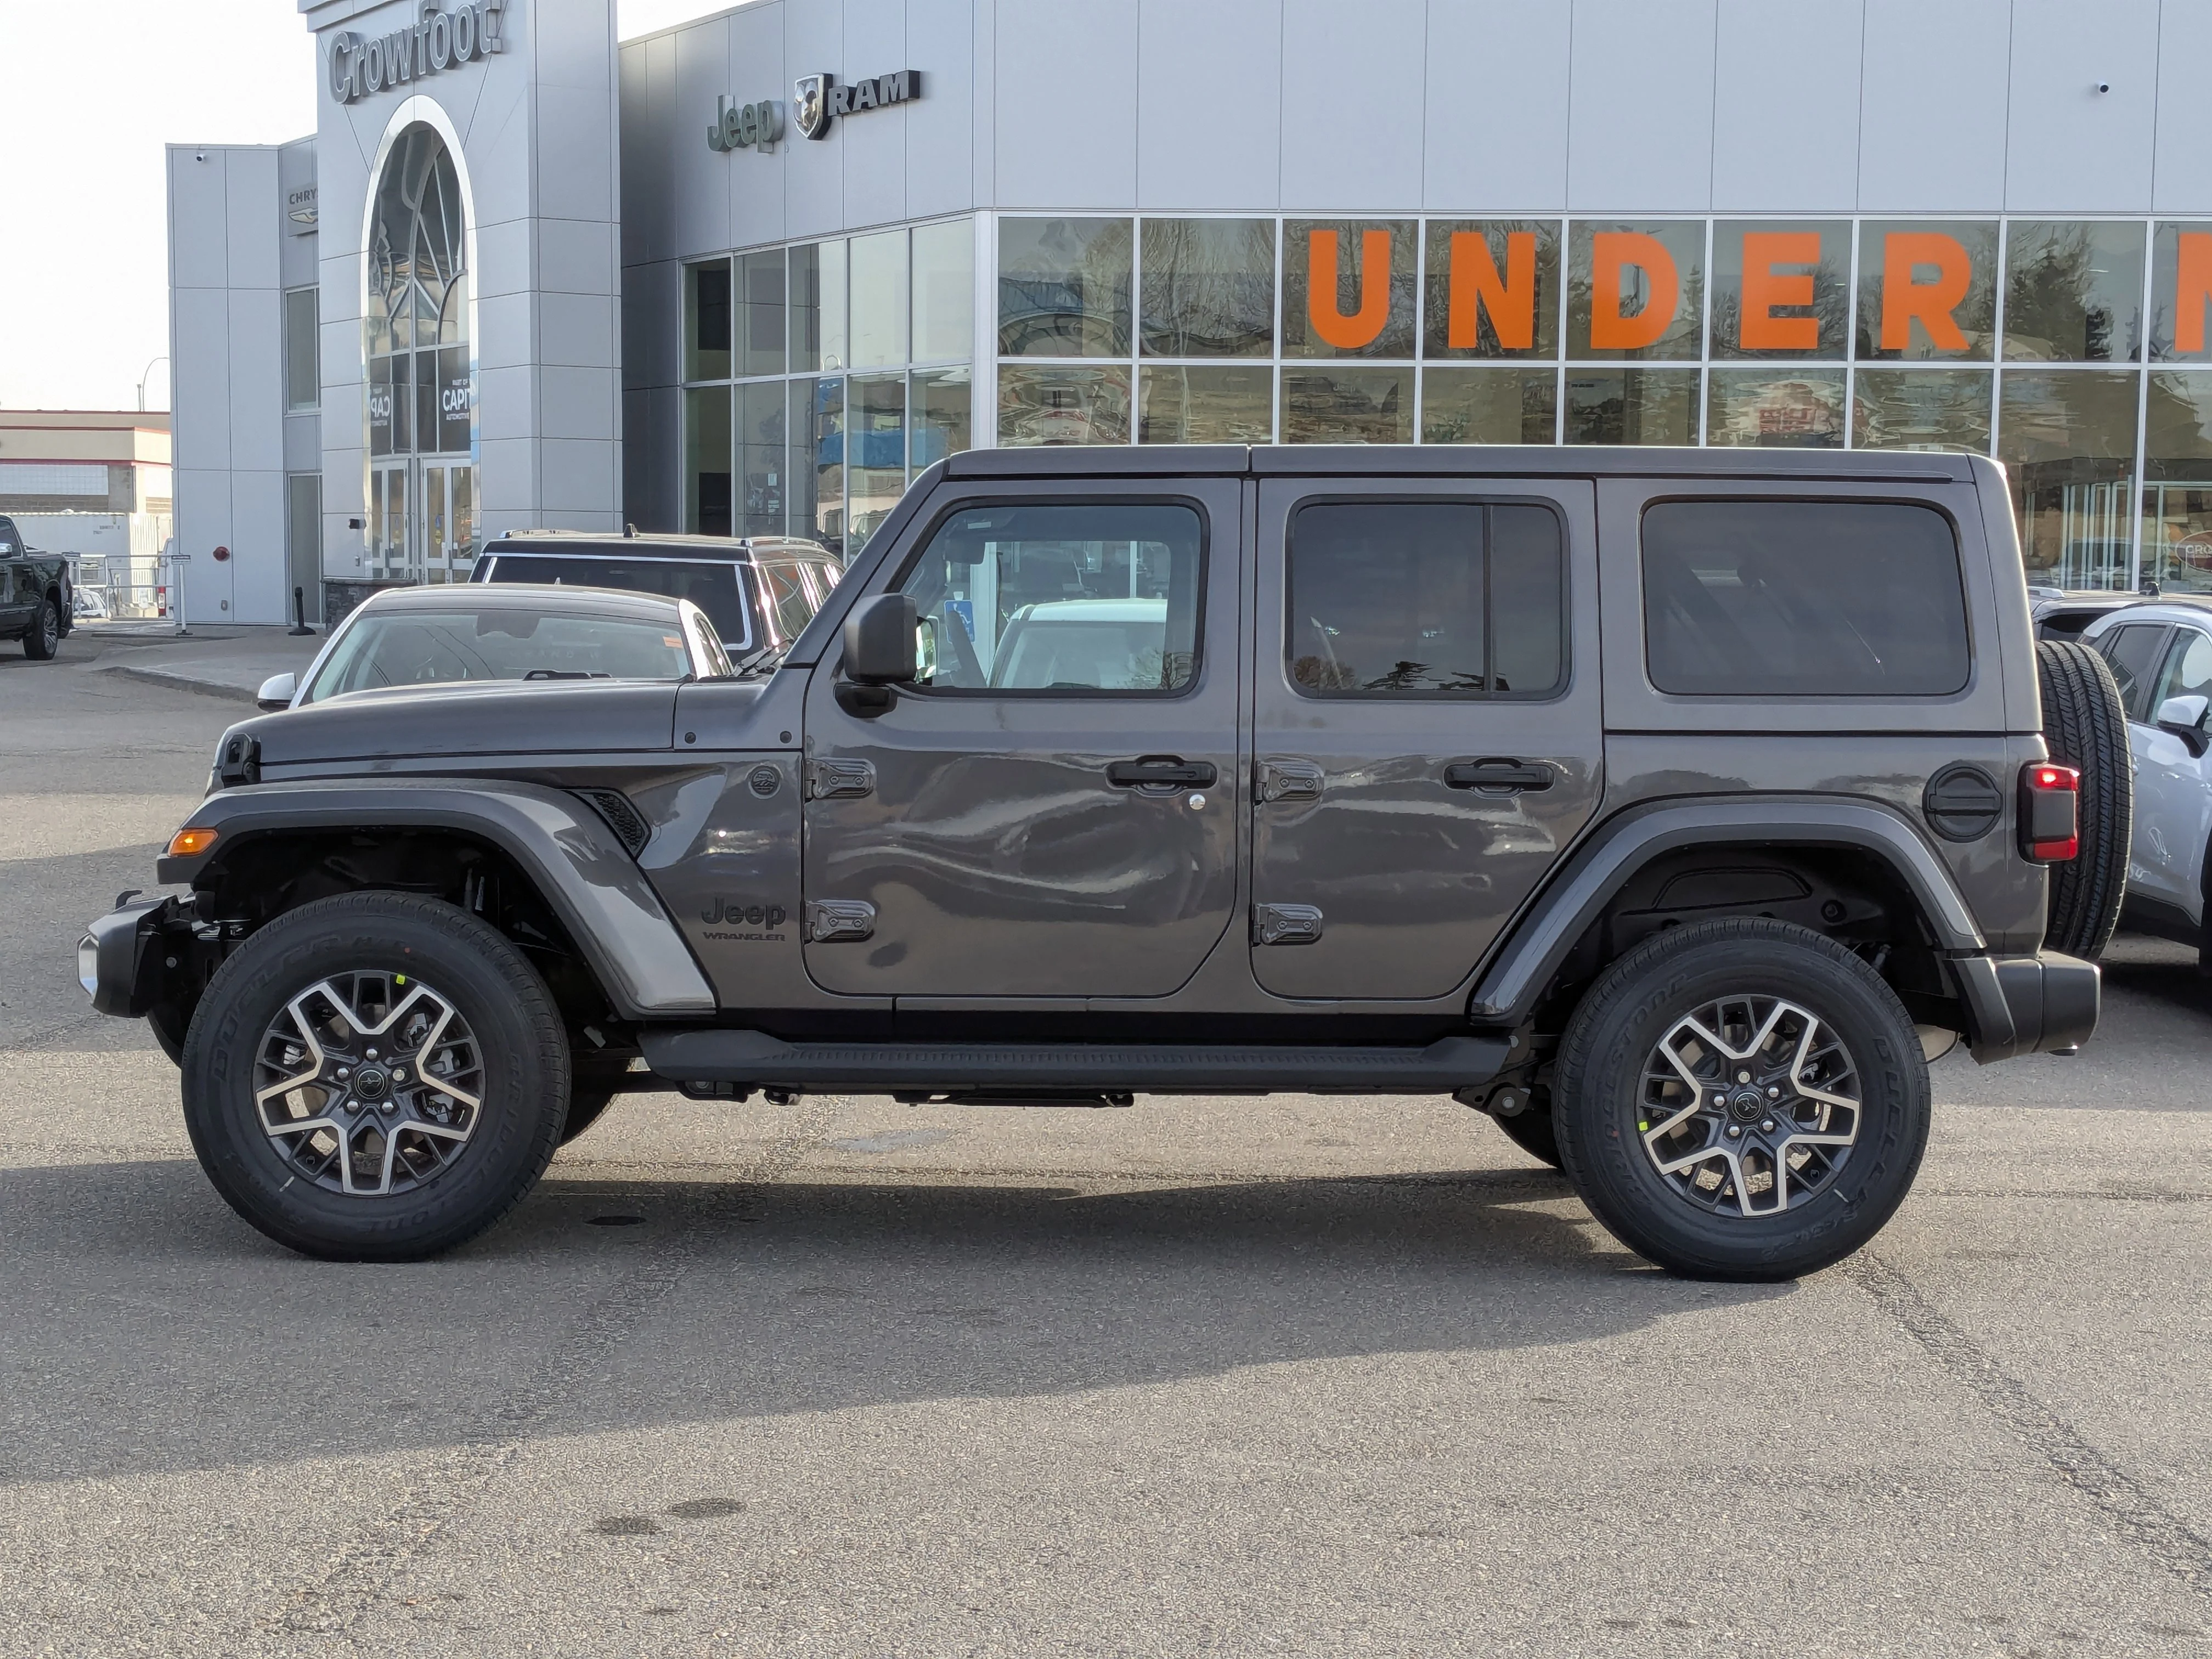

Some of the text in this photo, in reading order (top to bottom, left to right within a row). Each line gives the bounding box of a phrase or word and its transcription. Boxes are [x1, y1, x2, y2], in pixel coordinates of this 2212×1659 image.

[329, 0, 500, 104] Crowfoot
[828, 70, 920, 116] RAM
[707, 94, 785, 153] Jeep
[289, 188, 318, 205] CHRY
[1308, 230, 1972, 350] UNDER
[702, 898, 786, 930] Jeep
[703, 932, 786, 941] WRANGLER
